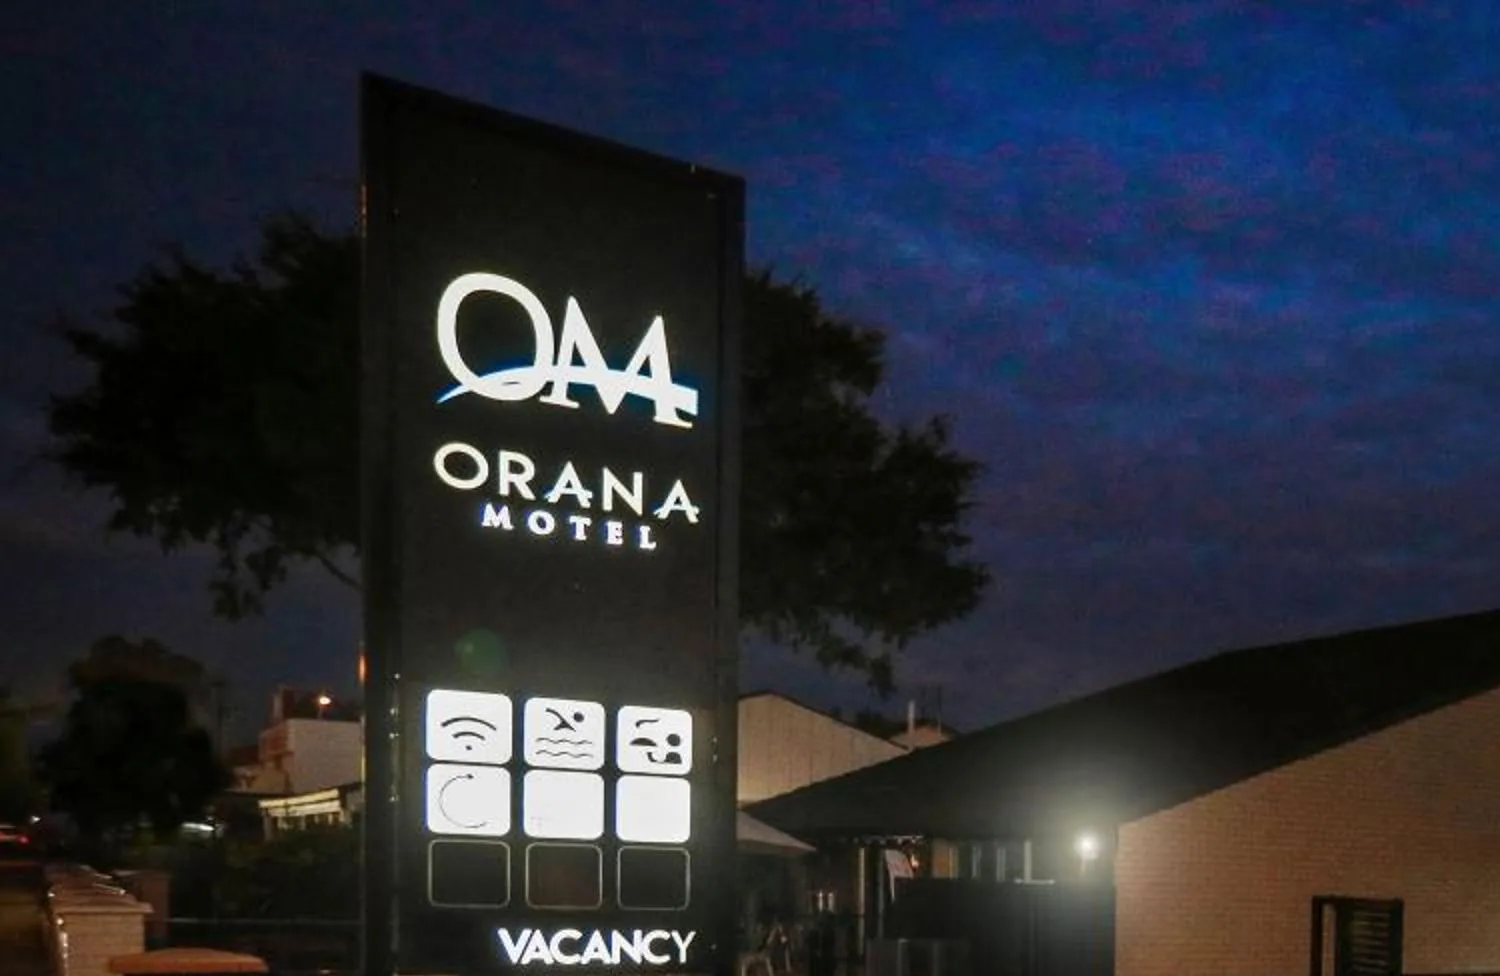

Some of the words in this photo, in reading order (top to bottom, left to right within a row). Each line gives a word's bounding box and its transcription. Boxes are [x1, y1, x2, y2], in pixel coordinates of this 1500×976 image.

[436, 271, 698, 428] OM
[433, 441, 700, 525] ORANA
[482, 503, 657, 550] MOTEL
[497, 928, 697, 965] VACANCY
